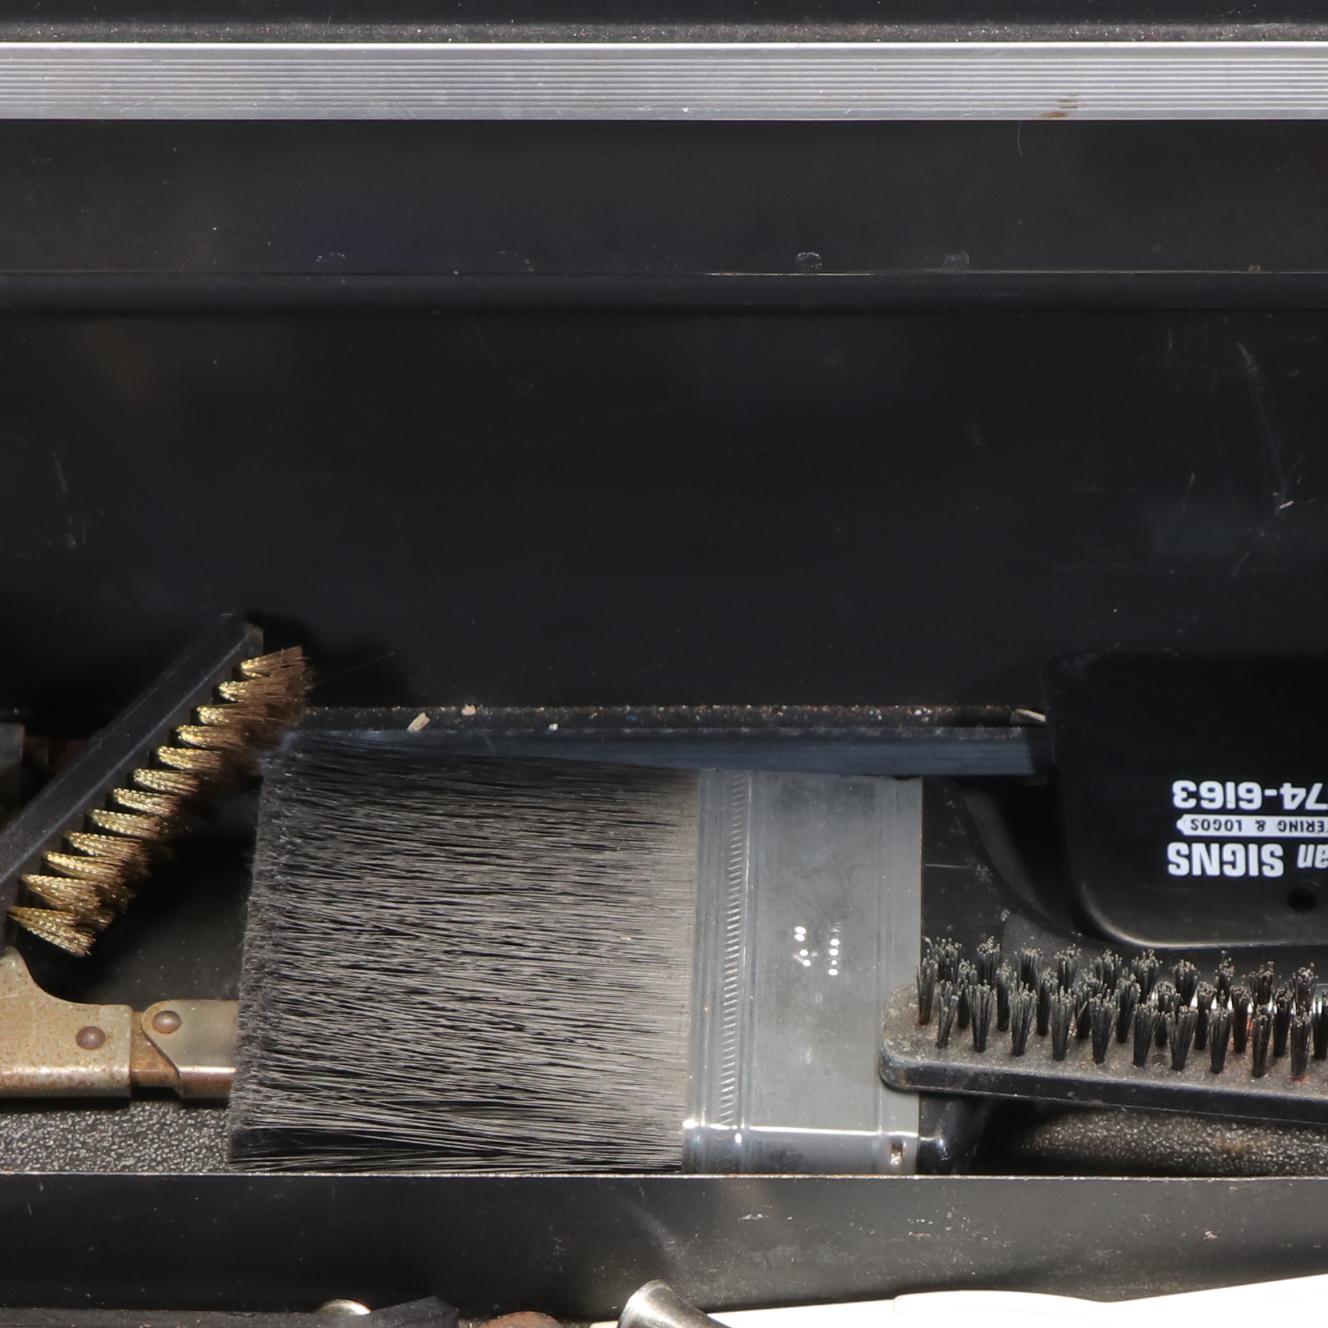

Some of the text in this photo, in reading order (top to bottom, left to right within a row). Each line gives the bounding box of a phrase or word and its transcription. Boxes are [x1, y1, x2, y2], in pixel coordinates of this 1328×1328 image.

[1189, 817, 1243, 832] LOGOS
[1255, 819, 1267, 833] &
[1167, 842, 1284, 877] SIGNS
